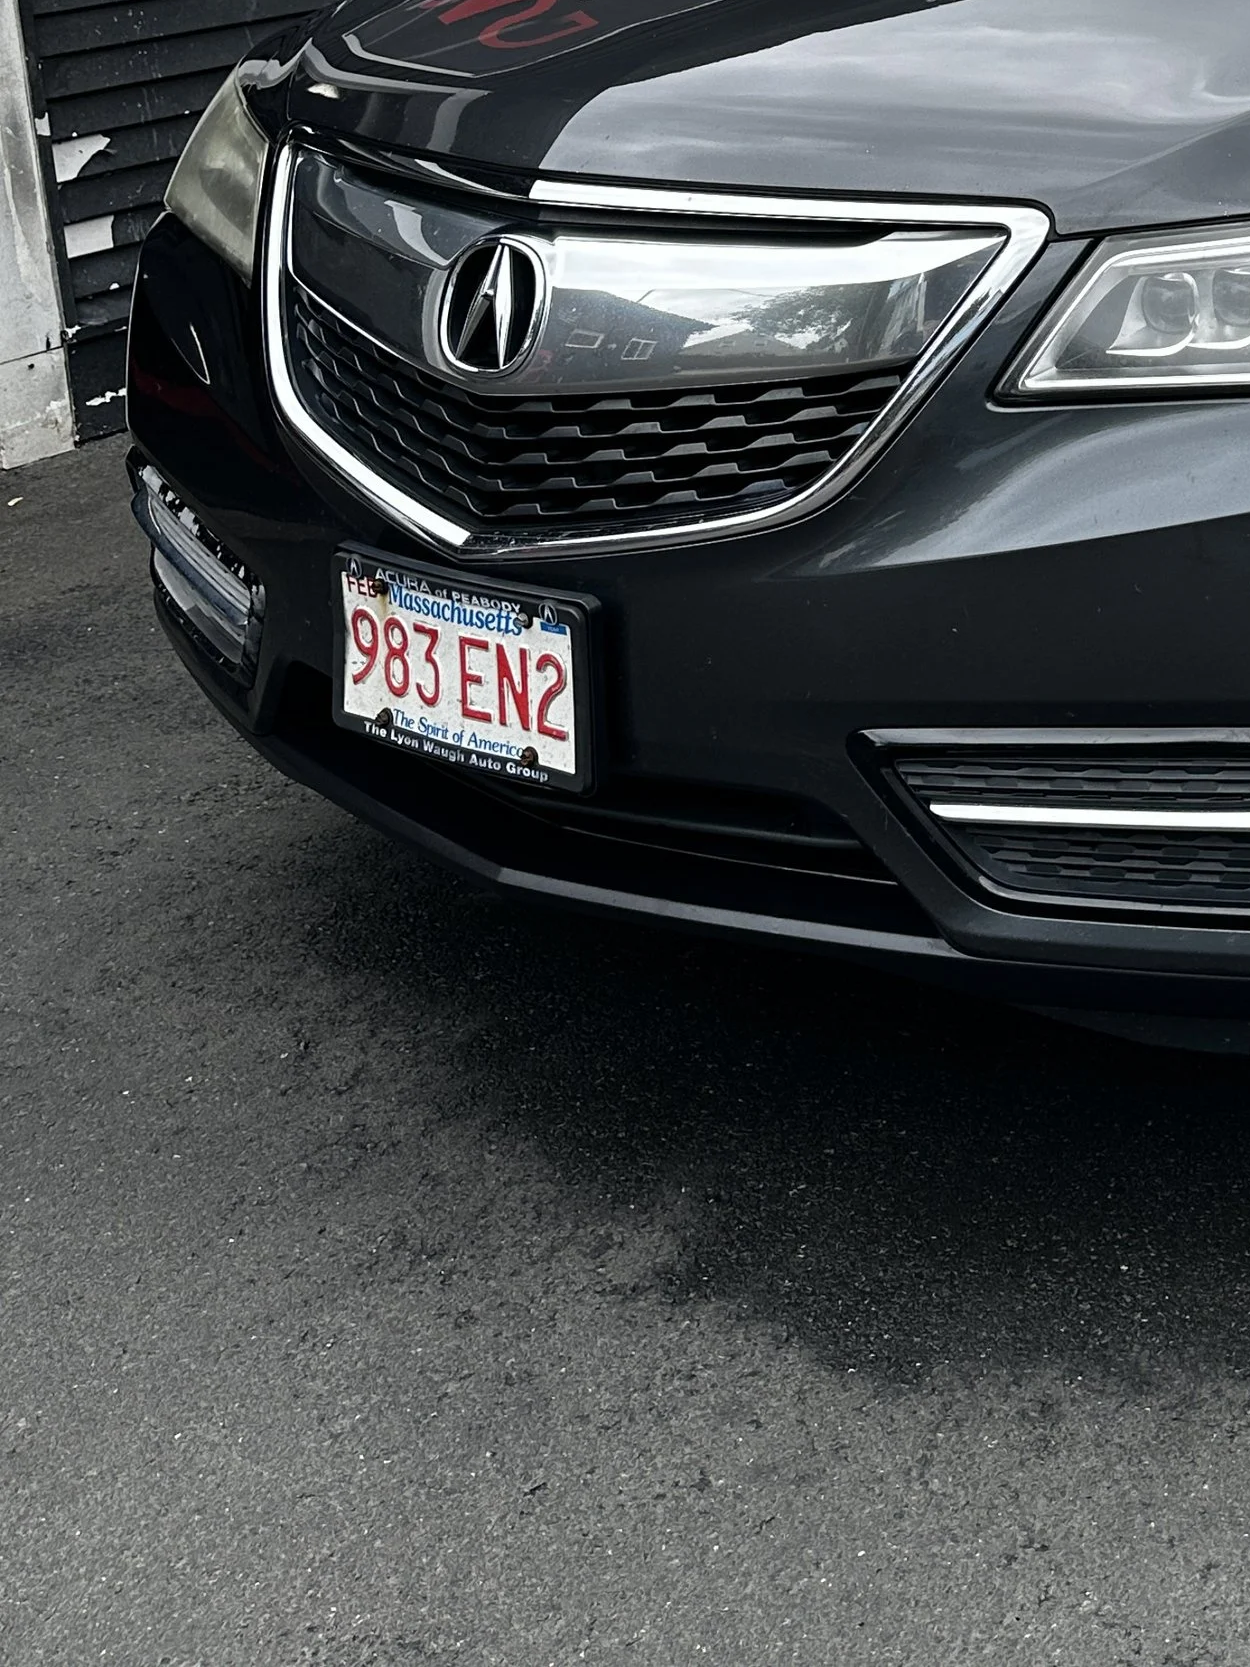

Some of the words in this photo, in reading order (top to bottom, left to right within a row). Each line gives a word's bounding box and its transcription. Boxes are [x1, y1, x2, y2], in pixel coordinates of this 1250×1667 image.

[375, 567, 432, 595] ACURA
[434, 588, 447, 600] of
[451, 591, 521, 614] PEABODY
[388, 584, 523, 636] Massachusetts
[351, 606, 440, 707] 983
[459, 635, 569, 742] EN2
[364, 720, 387, 739] The
[390, 728, 419, 749] Lyon
[422, 739, 464, 763] Waugh
[469, 754, 502, 772] Auto
[506, 762, 549, 783] Group
[393, 708, 415, 729] The
[418, 716, 449, 740] Spirit
[453, 730, 465, 745] of
